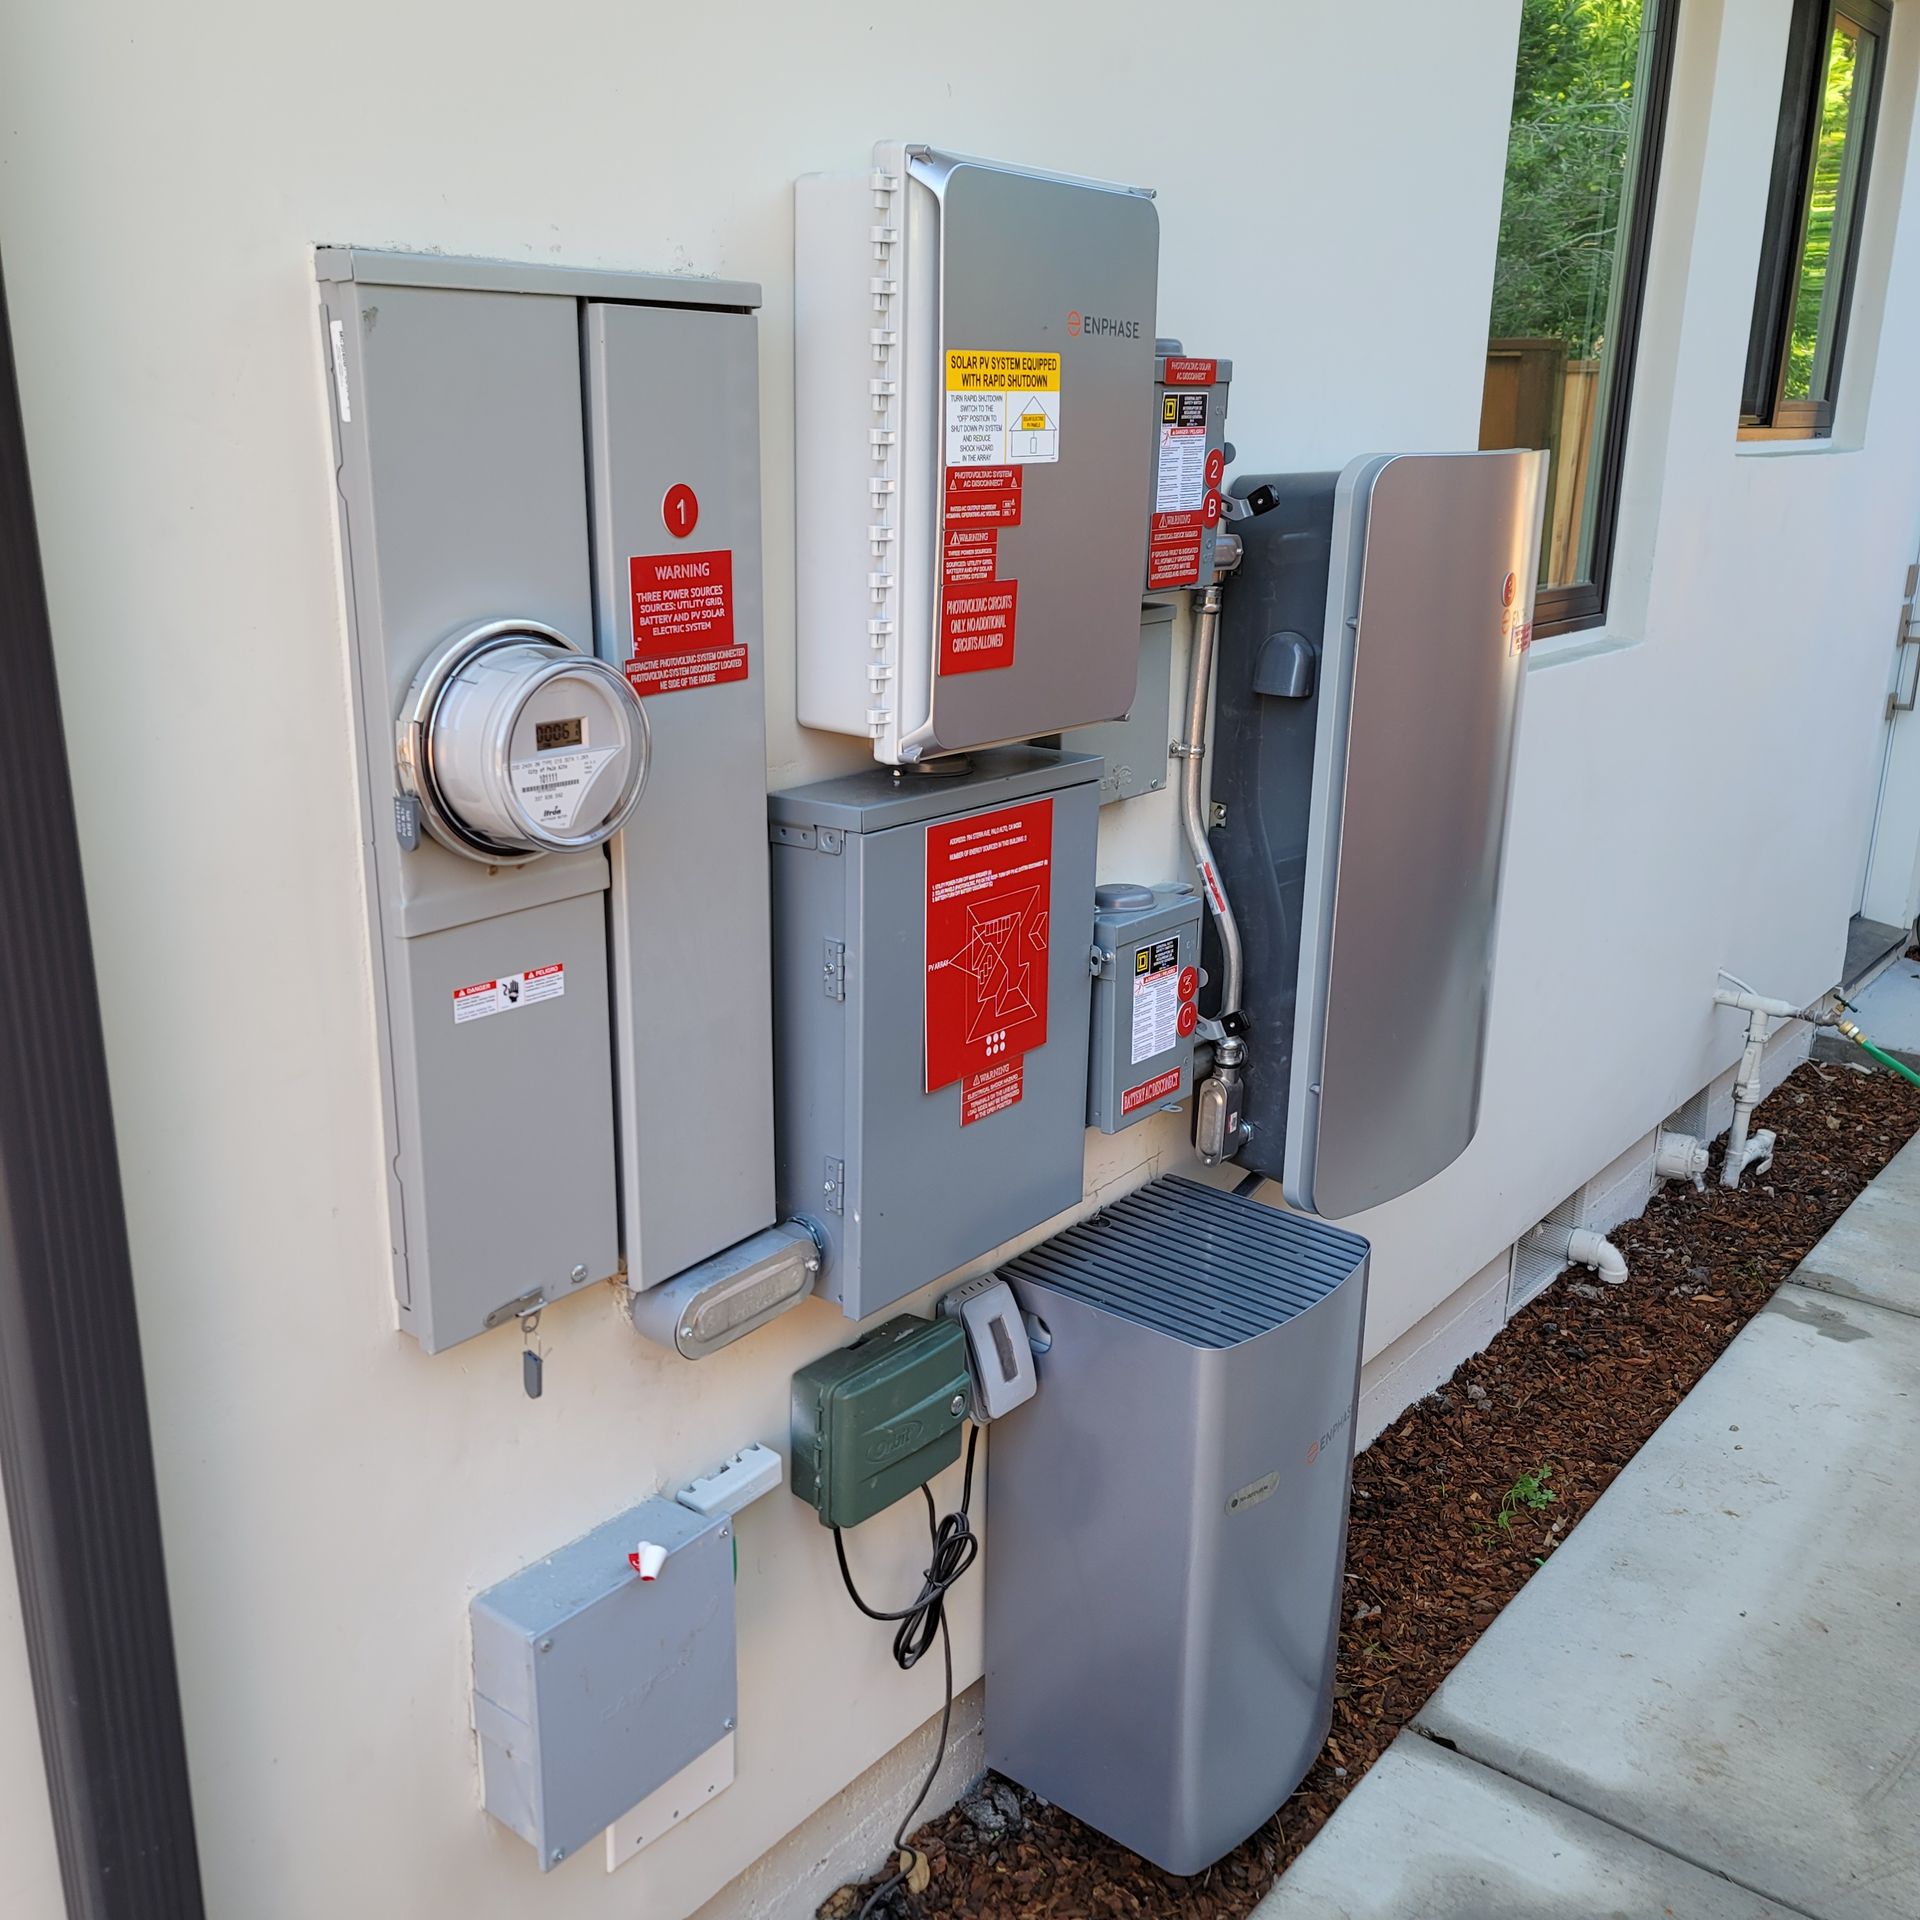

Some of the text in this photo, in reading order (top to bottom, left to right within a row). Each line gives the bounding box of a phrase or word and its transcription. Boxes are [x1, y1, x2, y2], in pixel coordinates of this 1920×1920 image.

[1084, 316, 1140, 338] ENPHASE
[951, 356, 1056, 370] SOLAR PV SYSTEM EQUIPPED
[962, 374, 1048, 387] WITH RAPID SHUTDOWN
[954, 471, 992, 479] PHOTOVOLTAIC
[1210, 460, 1218, 478] 2
[972, 480, 1004, 488] DISCONNECT
[676, 498, 684, 524] 1
[1208, 498, 1216, 518] B
[960, 532, 988, 542] WARNING
[654, 562, 710, 580] WARNING
[636, 585, 724, 603] THREE POWER SOURCES
[640, 597, 724, 614] SOURCES: UTILITY GRID,
[946, 594, 1012, 616] PHOTOVOLTAIC CIRCUITS
[640, 608, 726, 626] BATTERY AND PV SOLAR
[966, 618, 976, 632] NO
[976, 614, 1006, 631] ADDITIONAL
[652, 621, 712, 636] ELECTRIC SYSTEM
[952, 633, 1004, 653] CIRCUITS ALLOWED
[626, 648, 746, 674] INTERACTIVE PHOTOVOLTAIC SYSTEM CONNECTED
[630, 658, 742, 684] PHOTOVOLTAIC SYSTEM DISCONNECT LOCATED
[668, 678, 680, 689] SIDE
[680, 677, 688, 687] OF
[688, 676, 698, 685] THE
[698, 673, 716, 684] HOUSE
[535, 966, 558, 976] PELIGRO
[466, 983, 491, 994] DANGER
[1182, 974, 1192, 994] 3
[1182, 1006, 1192, 1028] C
[980, 1064, 1010, 1083] WARNING
[1124, 1087, 1146, 1110] BATTERY
